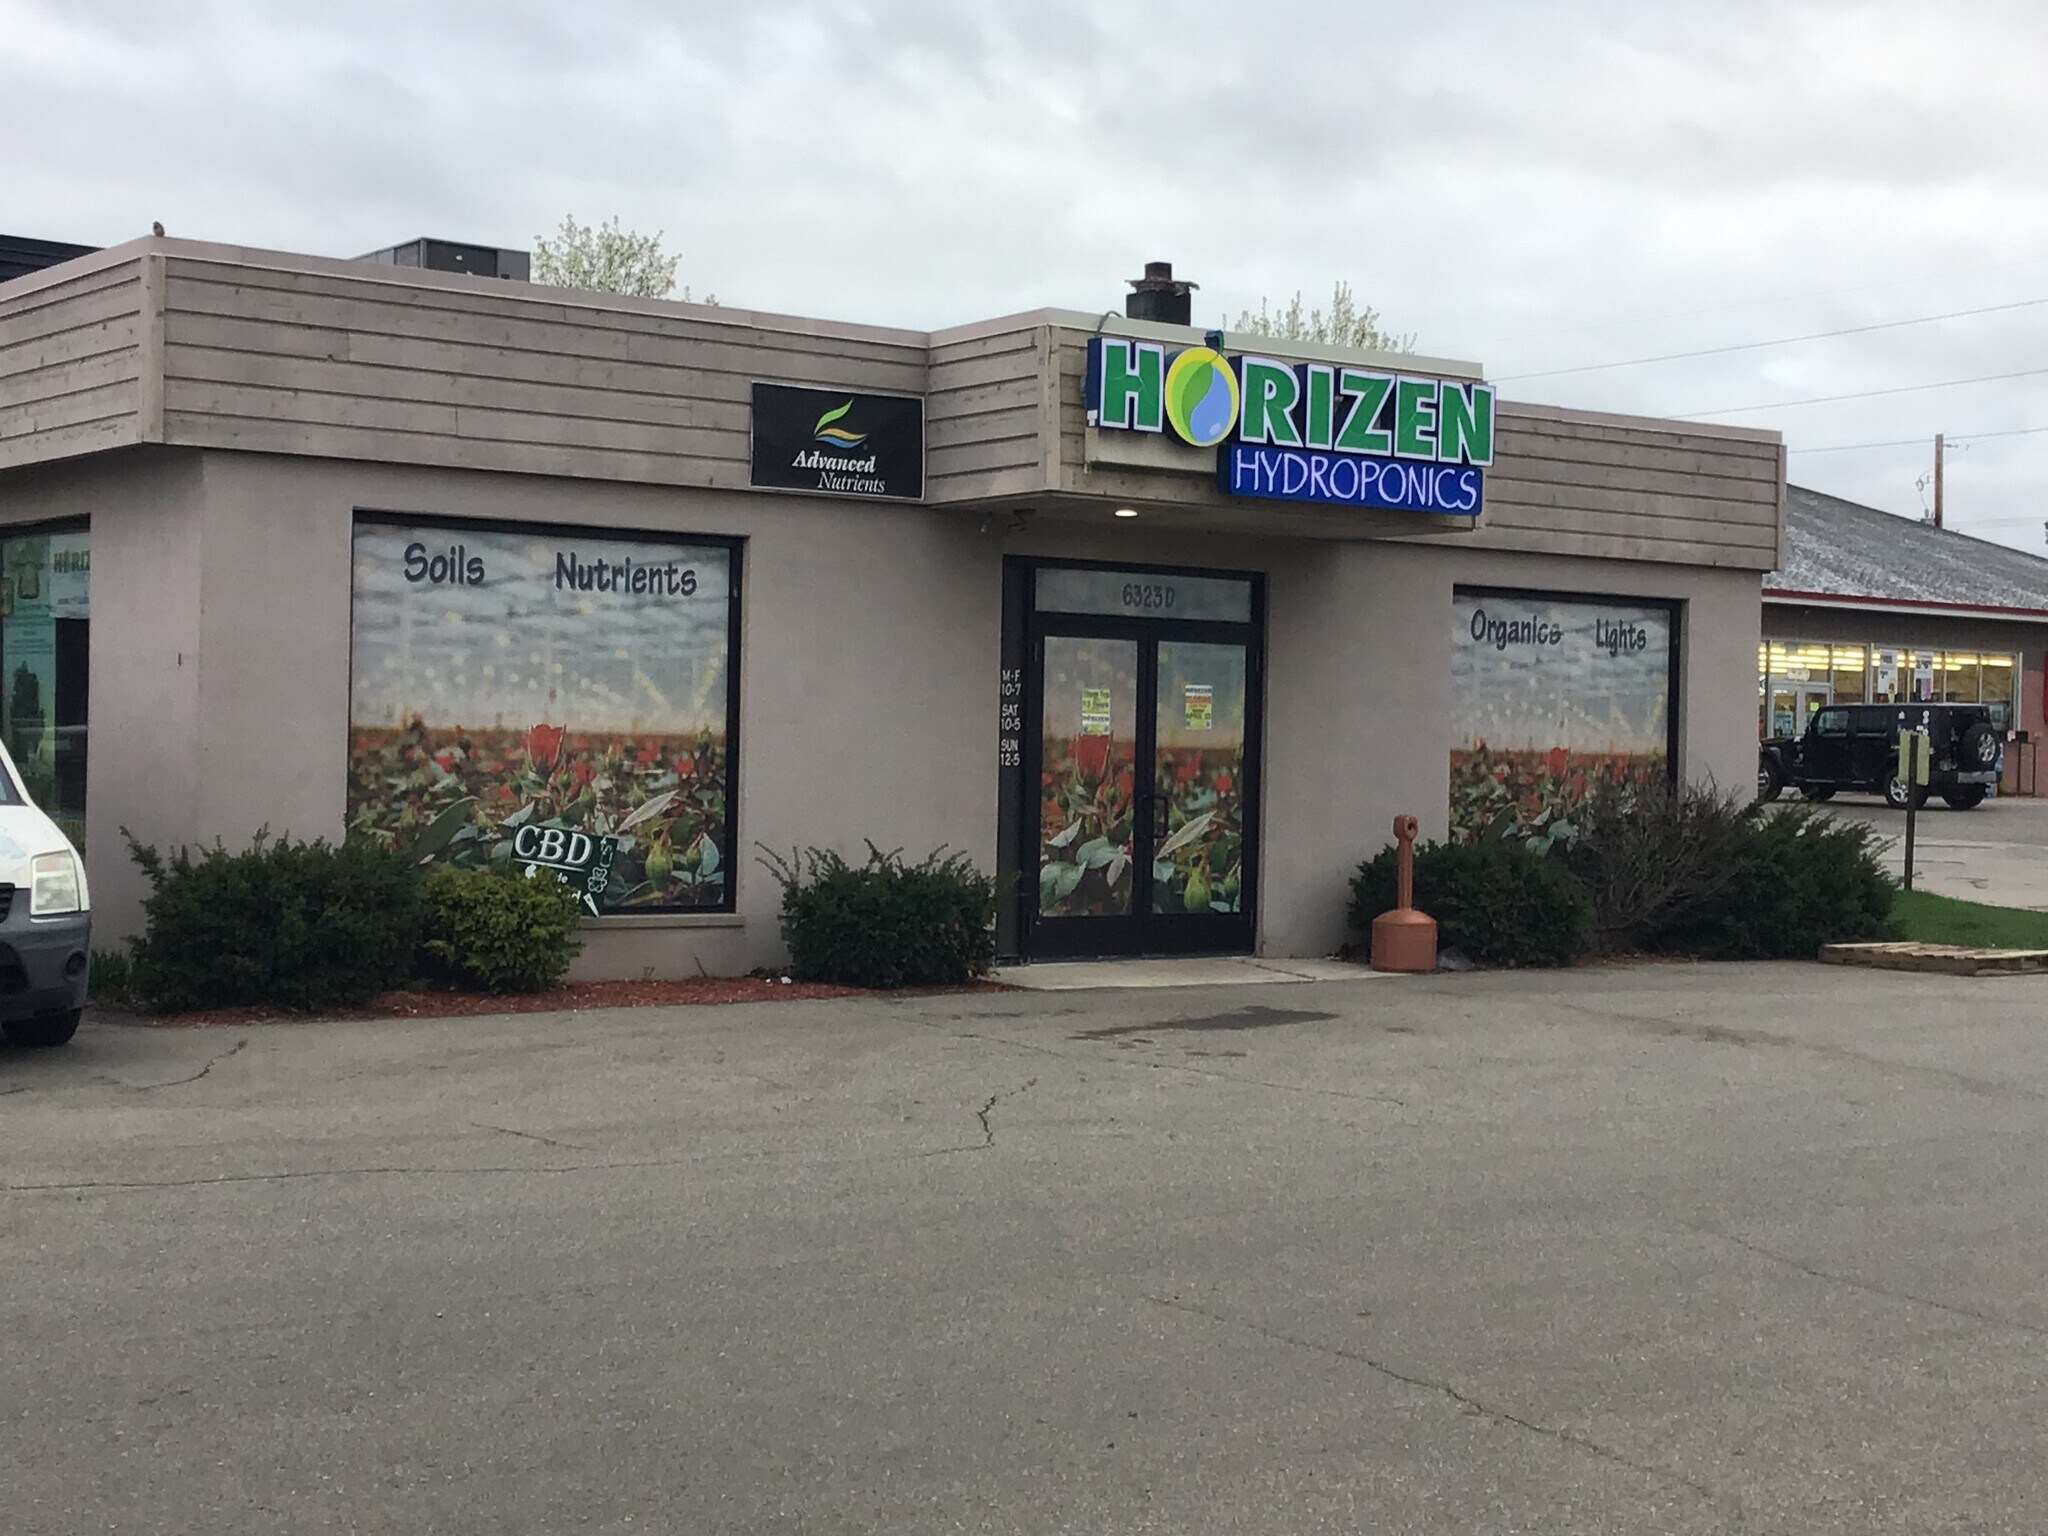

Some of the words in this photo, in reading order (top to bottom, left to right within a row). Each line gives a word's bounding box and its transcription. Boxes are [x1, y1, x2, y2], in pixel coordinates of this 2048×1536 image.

[1098, 337, 1496, 467] HORIZEN
[792, 450, 876, 474] Advanced
[817, 471, 886, 493] Nutrients
[1235, 448, 1478, 511] HYDROPONICS
[403, 542, 485, 585] Soils
[555, 551, 698, 596] Nutrients
[1470, 609, 1563, 650] Organics
[1595, 618, 1647, 657] Lights
[1001, 682, 1022, 696] 10-7
[1002, 703, 1019, 717] SAT
[1001, 717, 1021, 731] 10-5
[1001, 738, 1019, 751] SUN
[1000, 752, 1021, 766] 12-5
[514, 824, 593, 865] CBD
